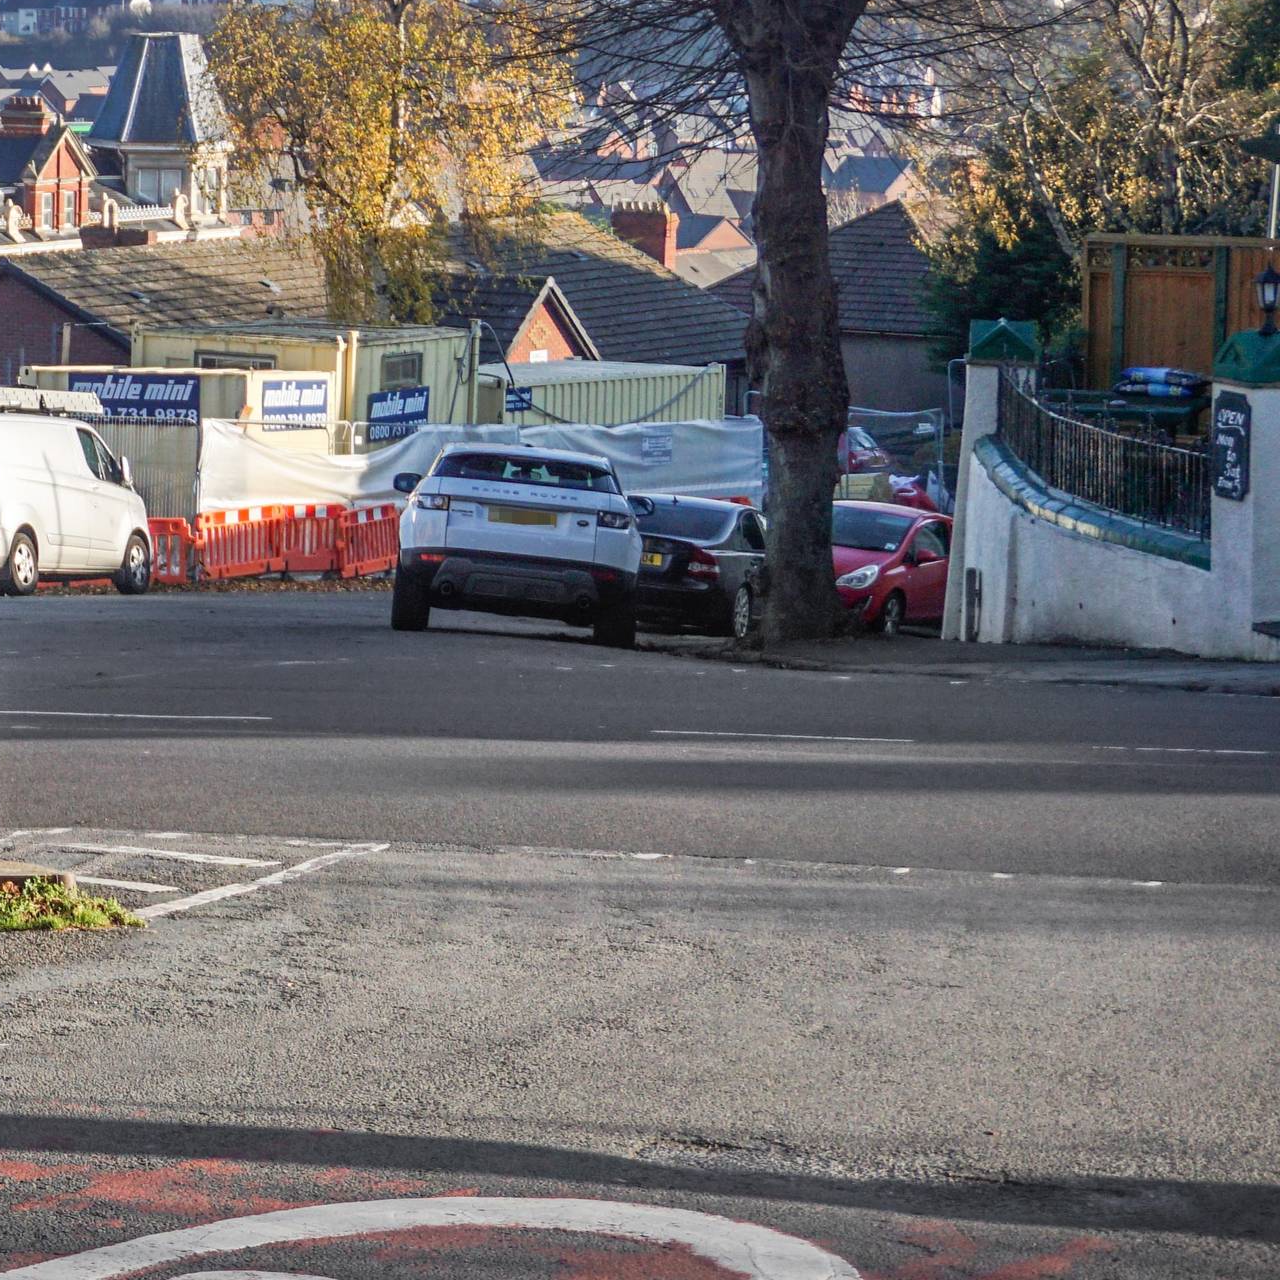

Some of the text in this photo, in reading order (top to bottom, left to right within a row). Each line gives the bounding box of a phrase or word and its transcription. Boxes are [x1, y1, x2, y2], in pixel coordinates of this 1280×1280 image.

[72, 375, 195, 401] mobile mini
[263, 381, 326, 407] mobile mini
[370, 391, 427, 418] mobile mini
[1217, 409, 1245, 425] OPEN
[370, 425, 390, 440] 0800
